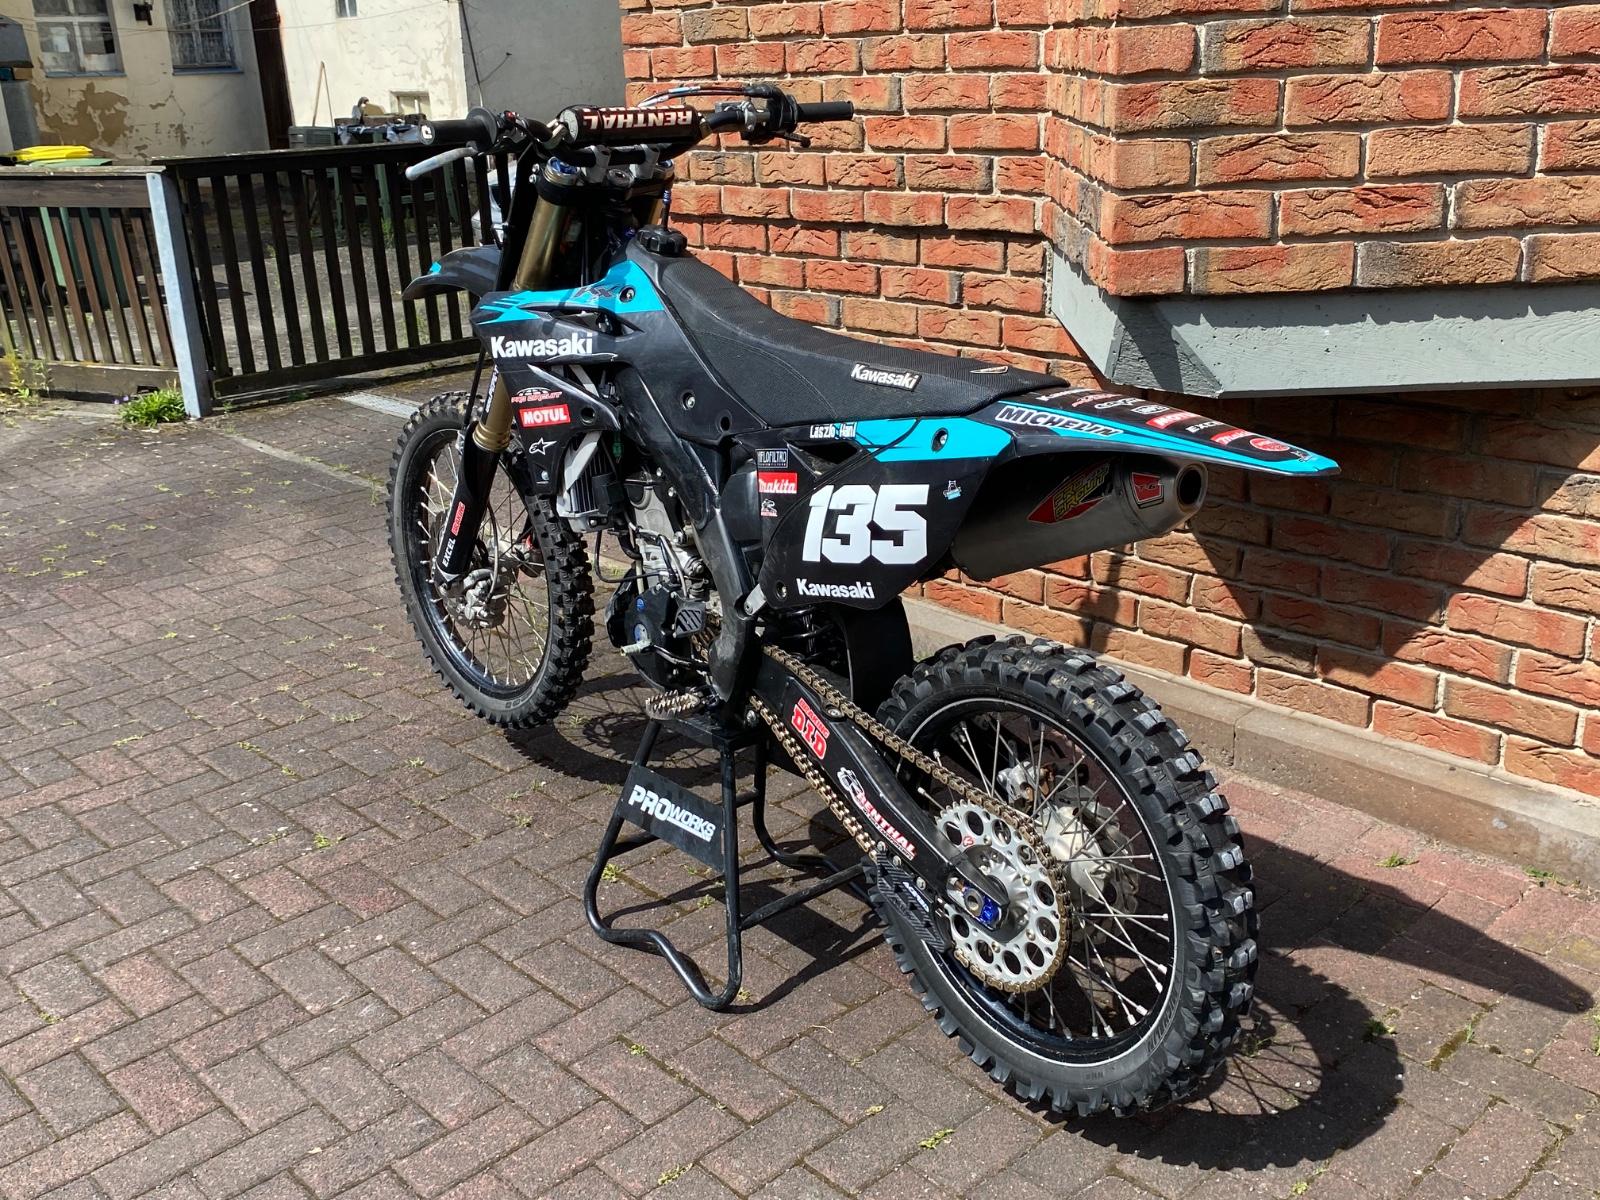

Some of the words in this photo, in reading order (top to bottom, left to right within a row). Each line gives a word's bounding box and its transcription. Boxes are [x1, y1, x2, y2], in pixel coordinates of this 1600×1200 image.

[583, 110, 693, 130] RENTHAL
[490, 332, 593, 359] Kawasaki
[850, 363, 919, 389] Kawasaki
[523, 407, 567, 425] MOTUL
[996, 405, 1124, 437] MICHELIN
[758, 478, 797, 494] makita
[802, 484, 930, 565] 135
[441, 537, 457, 568] EXCEL
[796, 577, 875, 599] Kawasaki
[791, 703, 827, 760] DID
[628, 784, 717, 842] PROWORKS
[857, 791, 918, 855] RENTHAL
